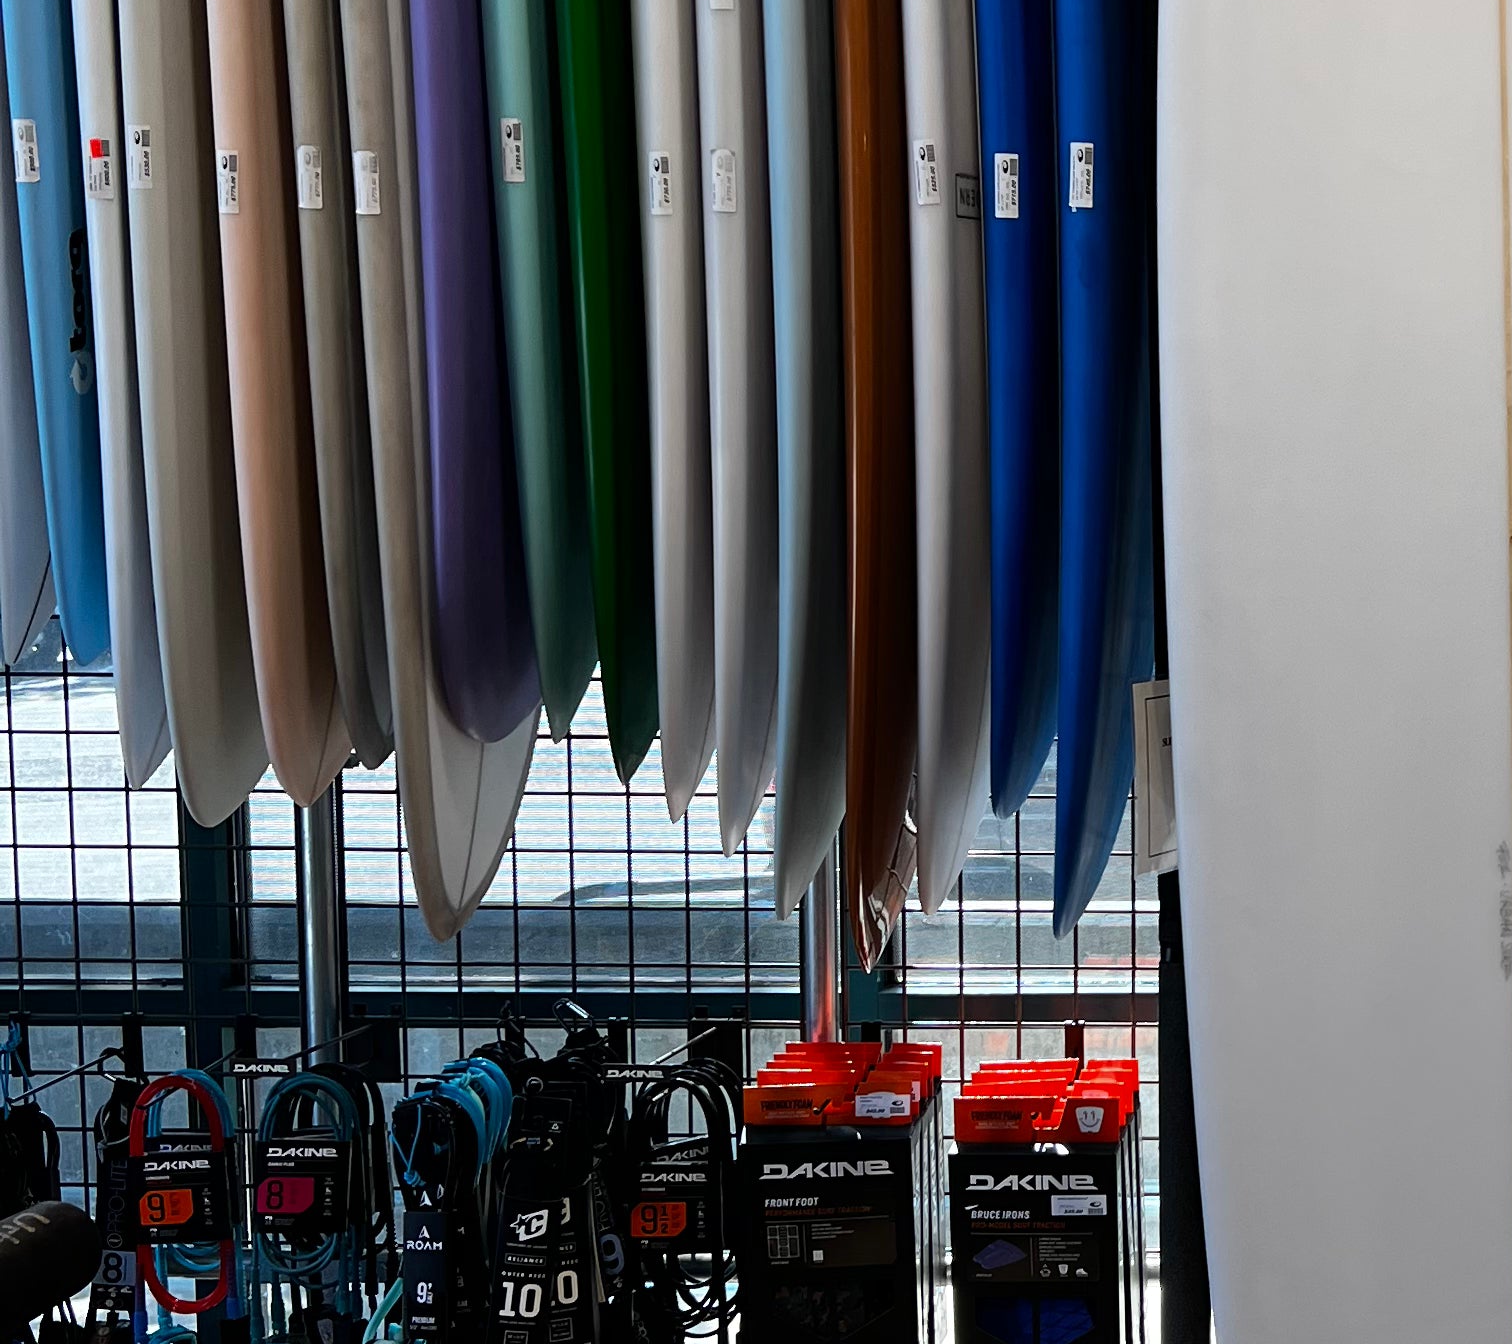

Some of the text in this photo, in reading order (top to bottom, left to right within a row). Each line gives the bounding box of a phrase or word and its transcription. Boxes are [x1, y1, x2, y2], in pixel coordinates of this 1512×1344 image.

[232, 1063, 290, 1074] DAKINE
[605, 1069, 664, 1079] DAKINE
[266, 1147, 339, 1159] DAKINE
[142, 1159, 211, 1172] DAKINE
[758, 1159, 895, 1181] DAKINE
[640, 1172, 709, 1183] DAKINE
[965, 1174, 1099, 1191] DAKINE
[265, 1179, 284, 1210] 8
[146, 1193, 165, 1223] 9
[764, 1196, 819, 1208] FRONT FOOT
[970, 1210, 1031, 1220] BRUCE IRONS
[406, 1239, 443, 1251] ROAM
[102, 1252, 123, 1284] 8
[498, 1281, 542, 1318] 10
